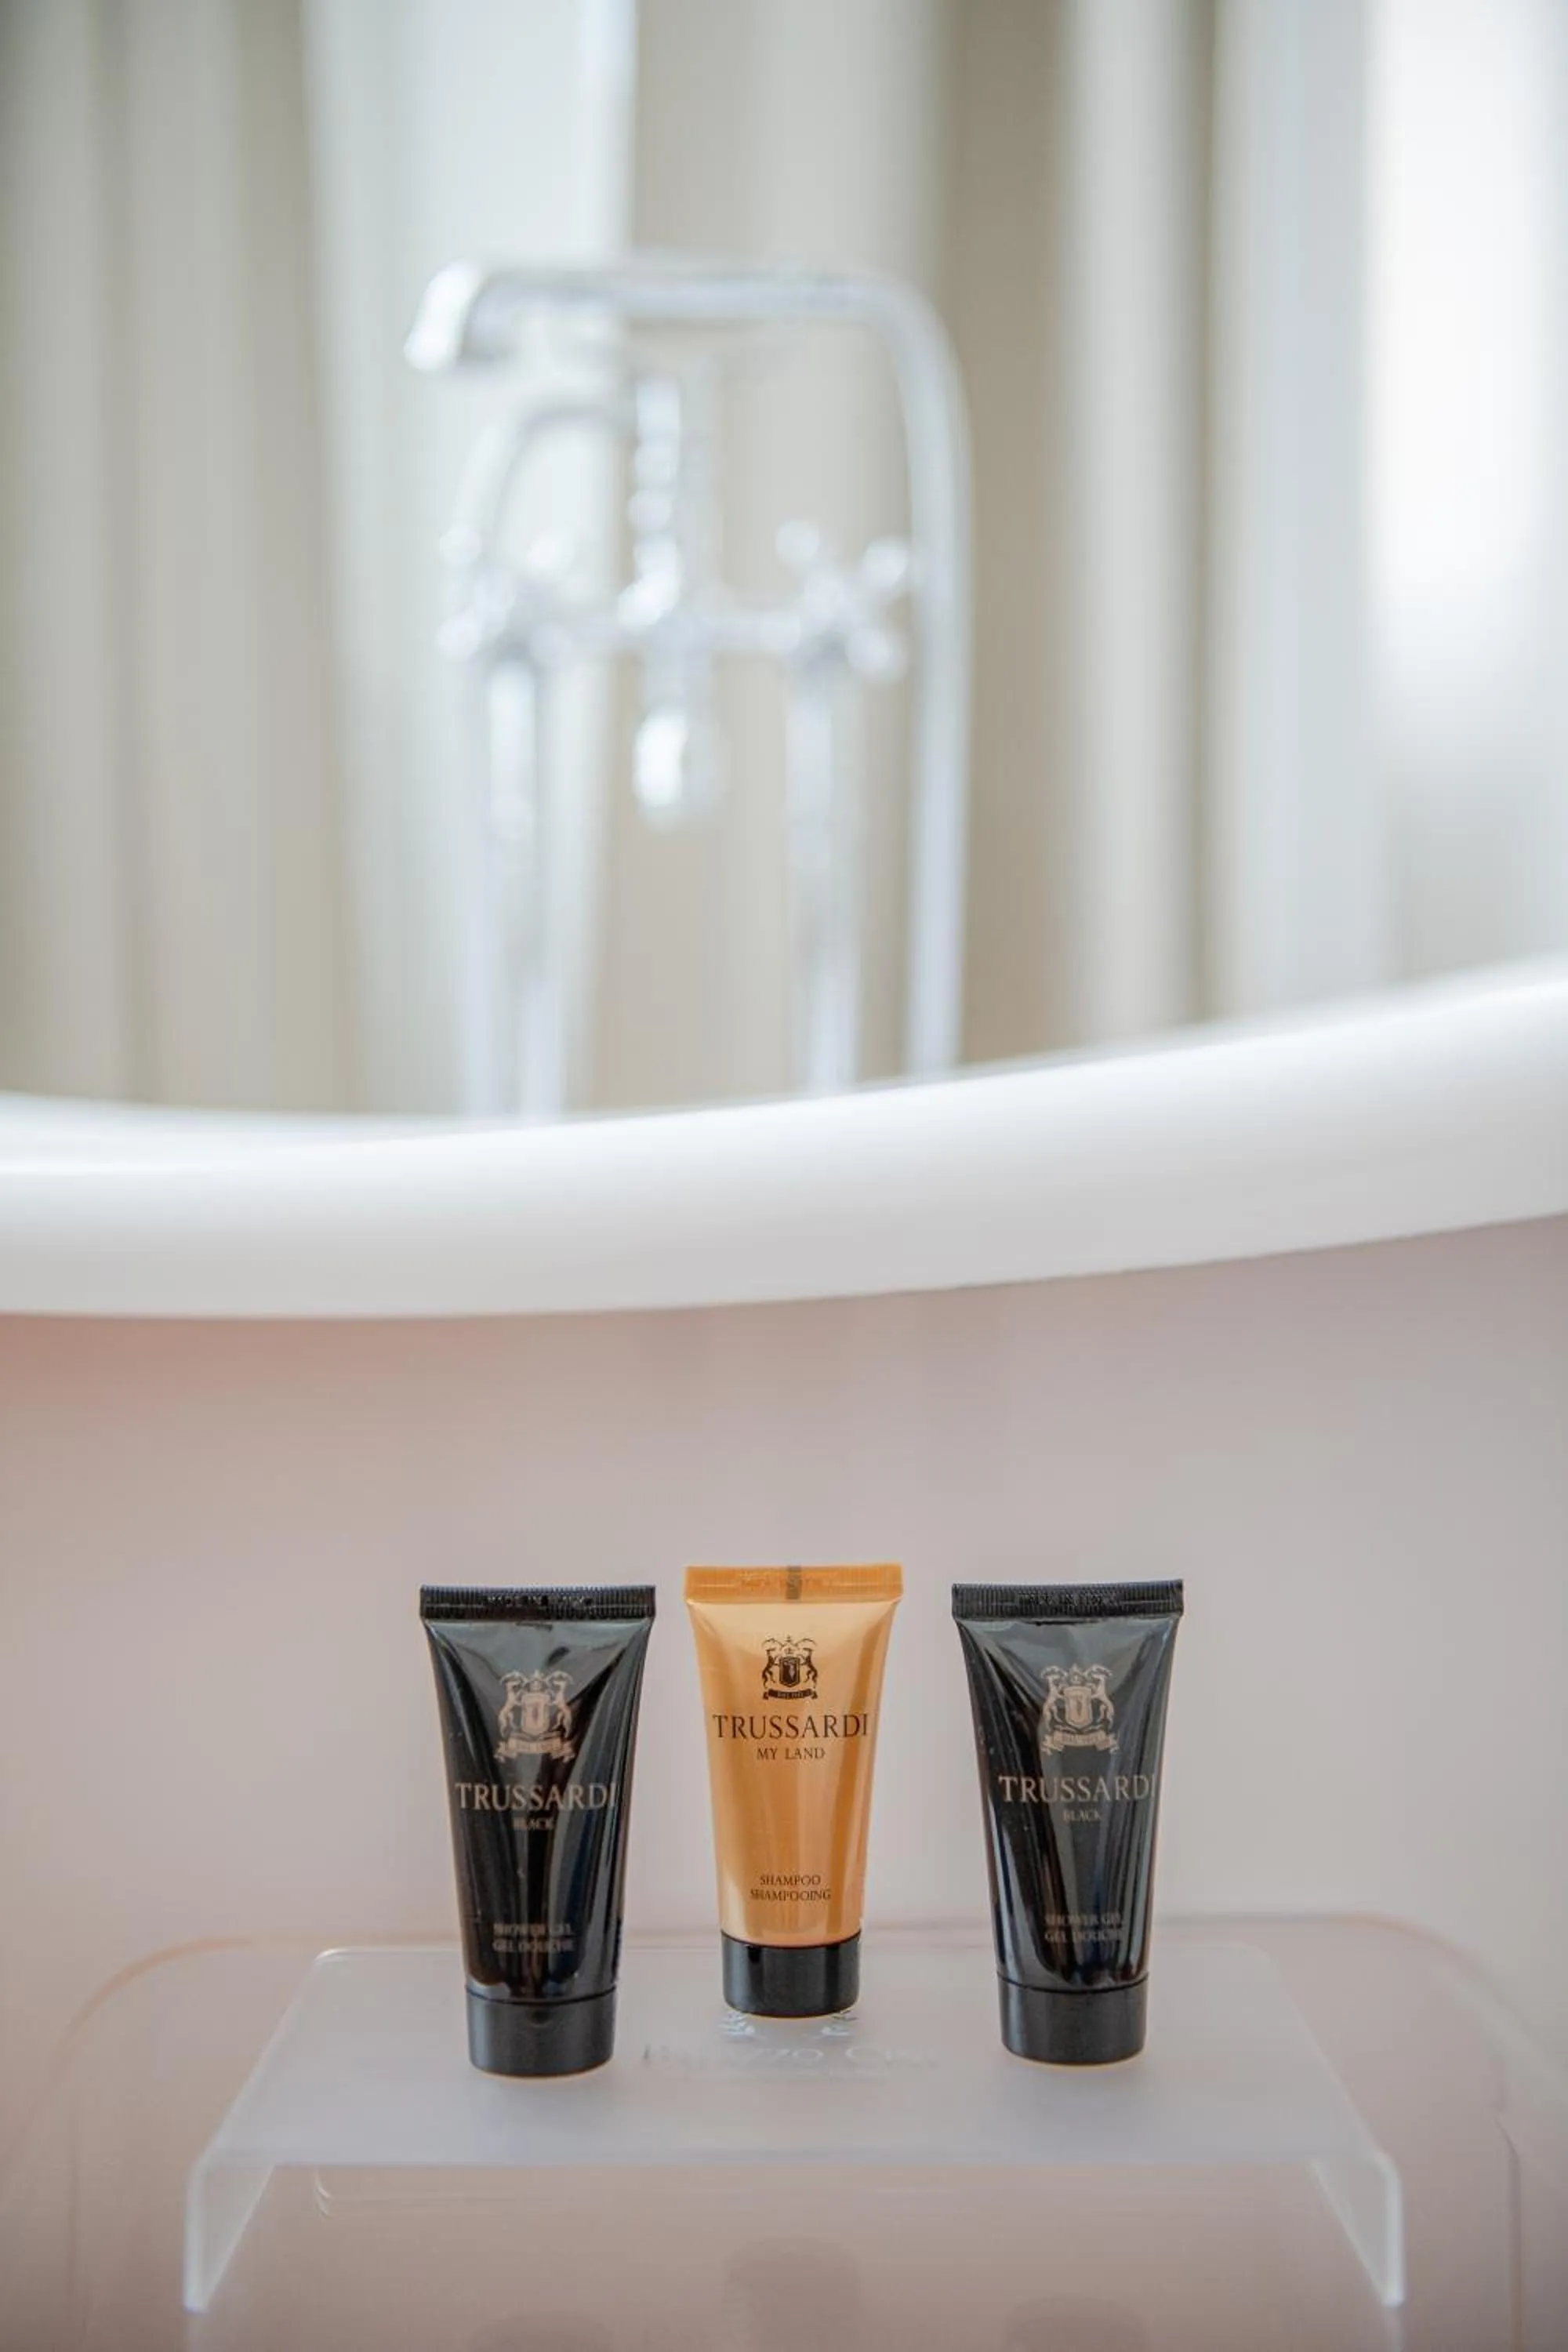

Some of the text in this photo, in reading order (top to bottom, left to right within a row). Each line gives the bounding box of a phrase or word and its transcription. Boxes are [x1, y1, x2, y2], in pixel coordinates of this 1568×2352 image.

[713, 1714, 869, 1739] TRUSSARDI
[757, 1748, 826, 1759] MY LAND
[454, 1781, 615, 1810] TRUSSARDI
[998, 1774, 1155, 1802] TRUSSARDI
[760, 1874, 821, 1886] SHAMPOO
[750, 1889, 830, 1901] SHAMPOOING
